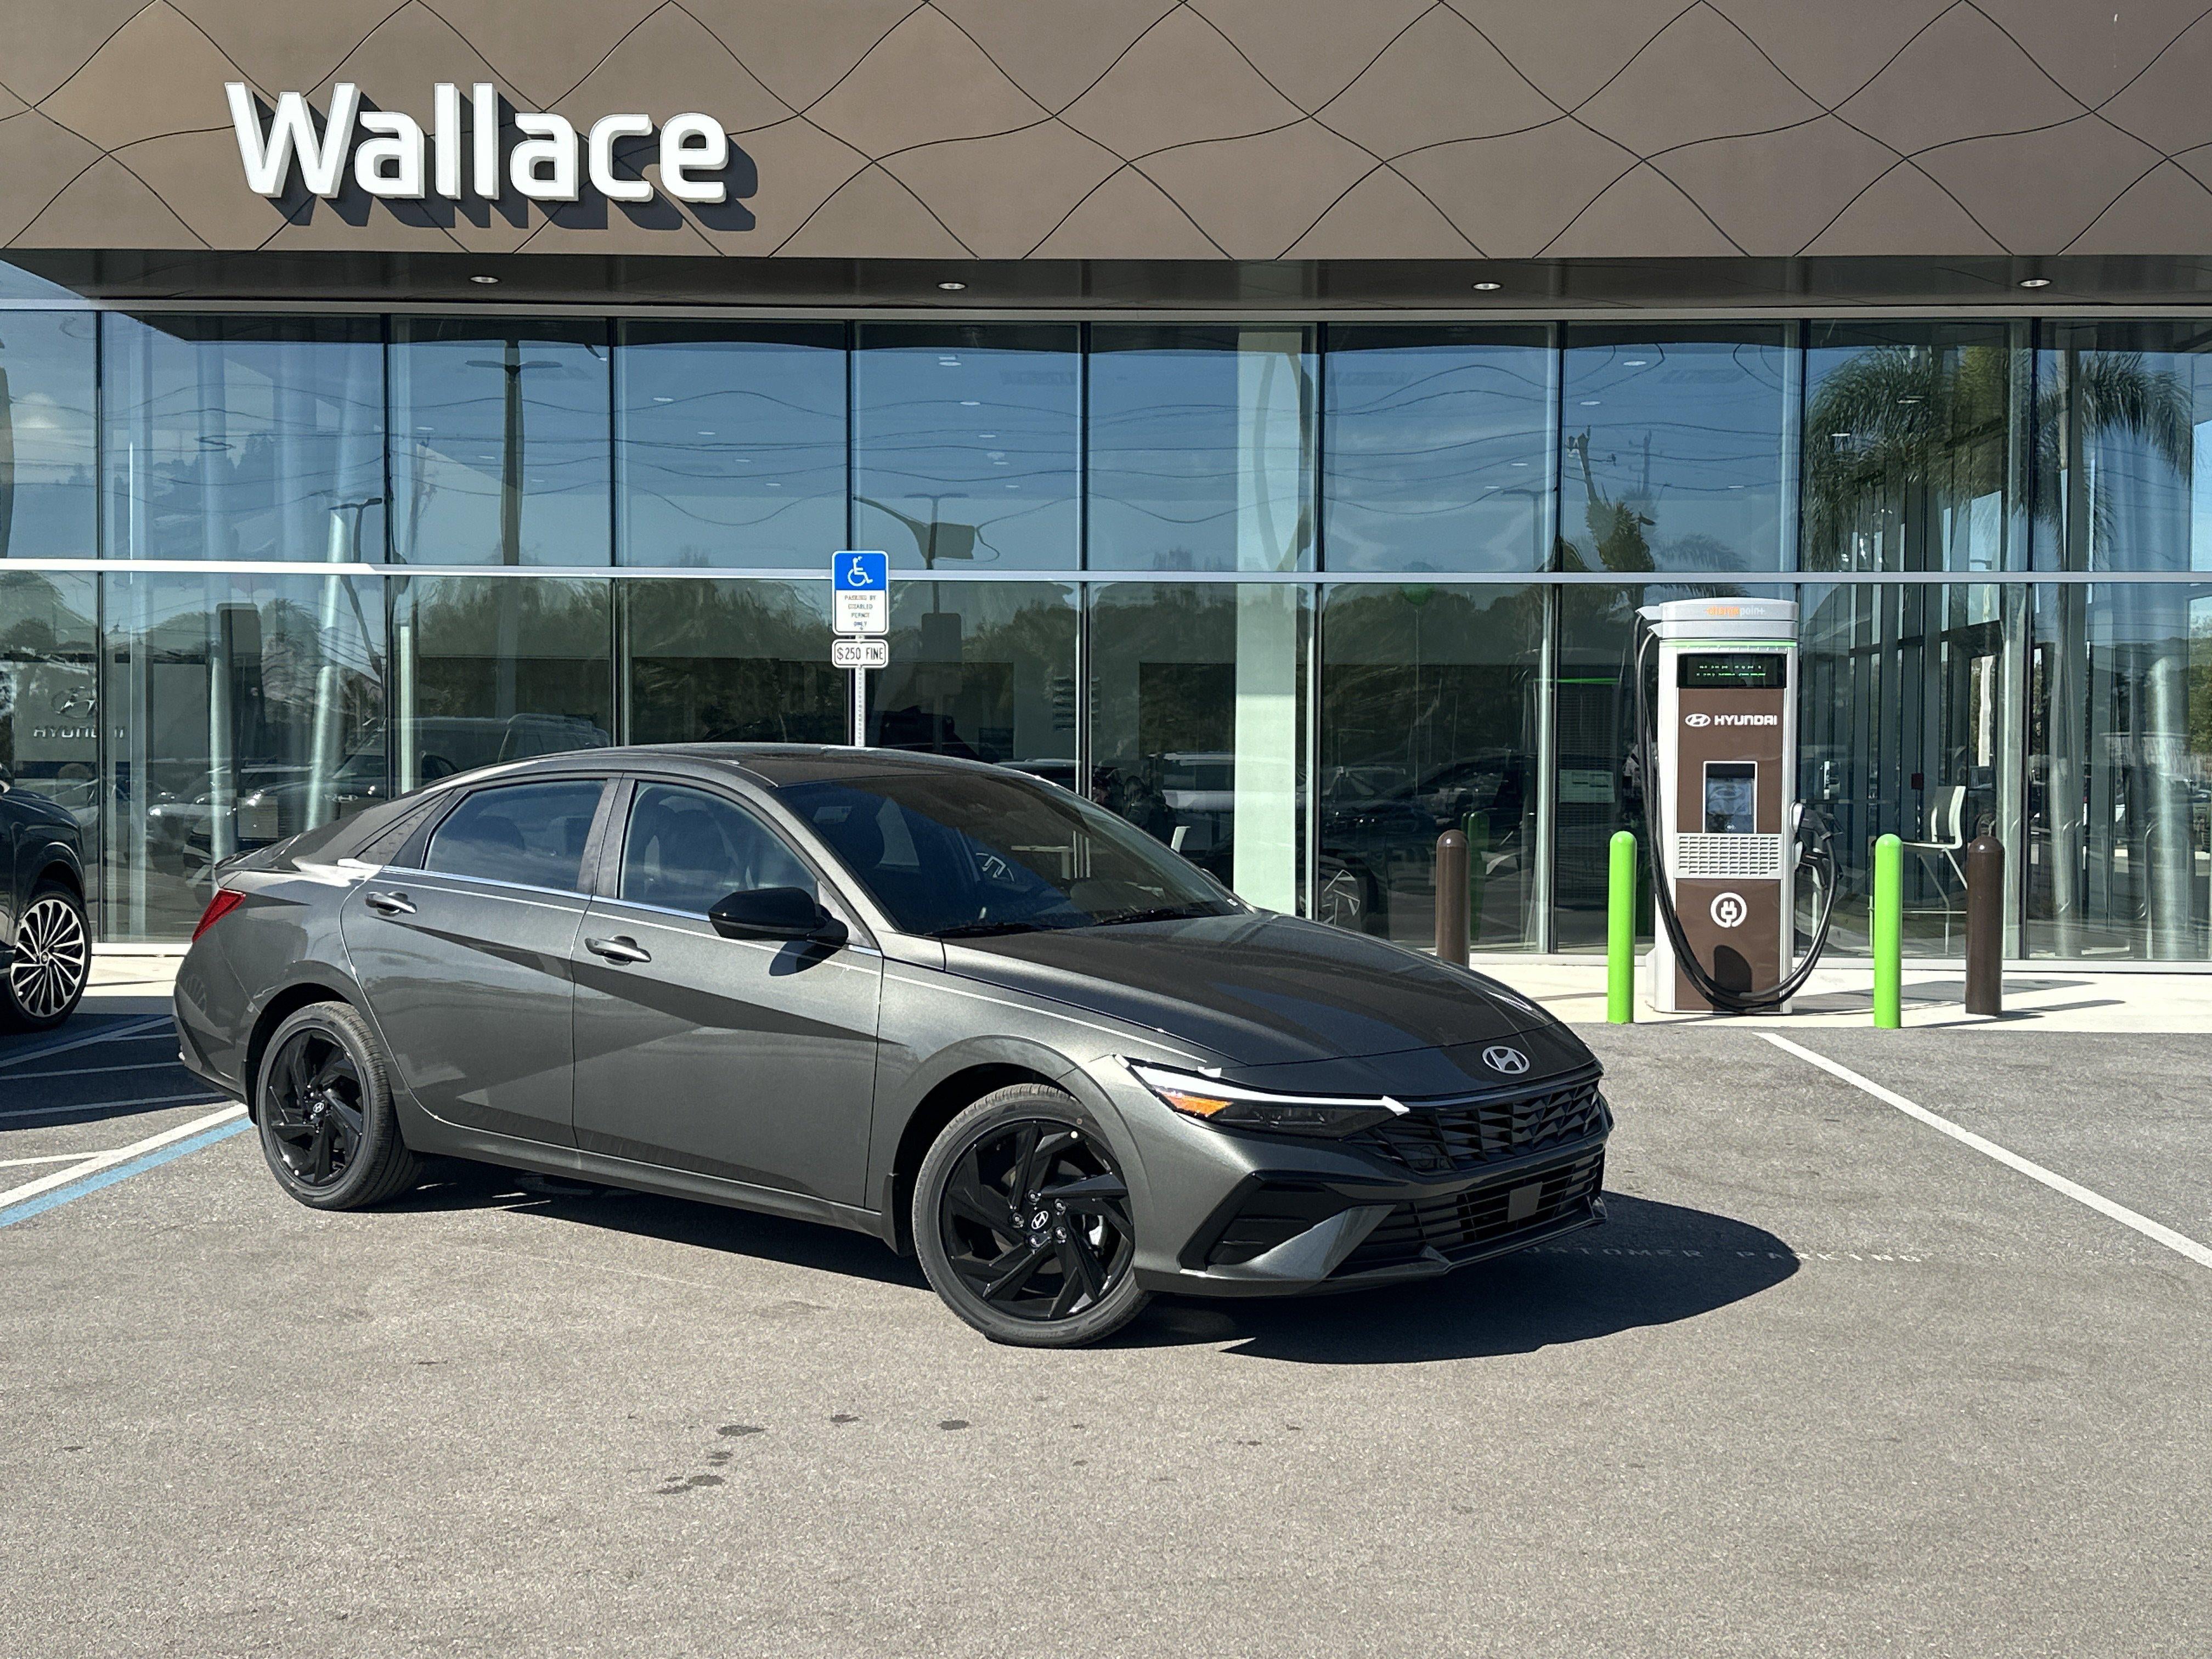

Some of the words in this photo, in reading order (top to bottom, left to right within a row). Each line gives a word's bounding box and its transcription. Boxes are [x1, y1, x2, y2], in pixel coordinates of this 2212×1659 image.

[224, 82, 730, 204] Wallace
[837, 647, 861, 661] $250
[866, 647, 883, 660] FINE
[1714, 715, 1777, 726] HYUNDAI
[33, 725, 125, 738] HYUNI
[1523, 1246, 1703, 1257] USTOMER
